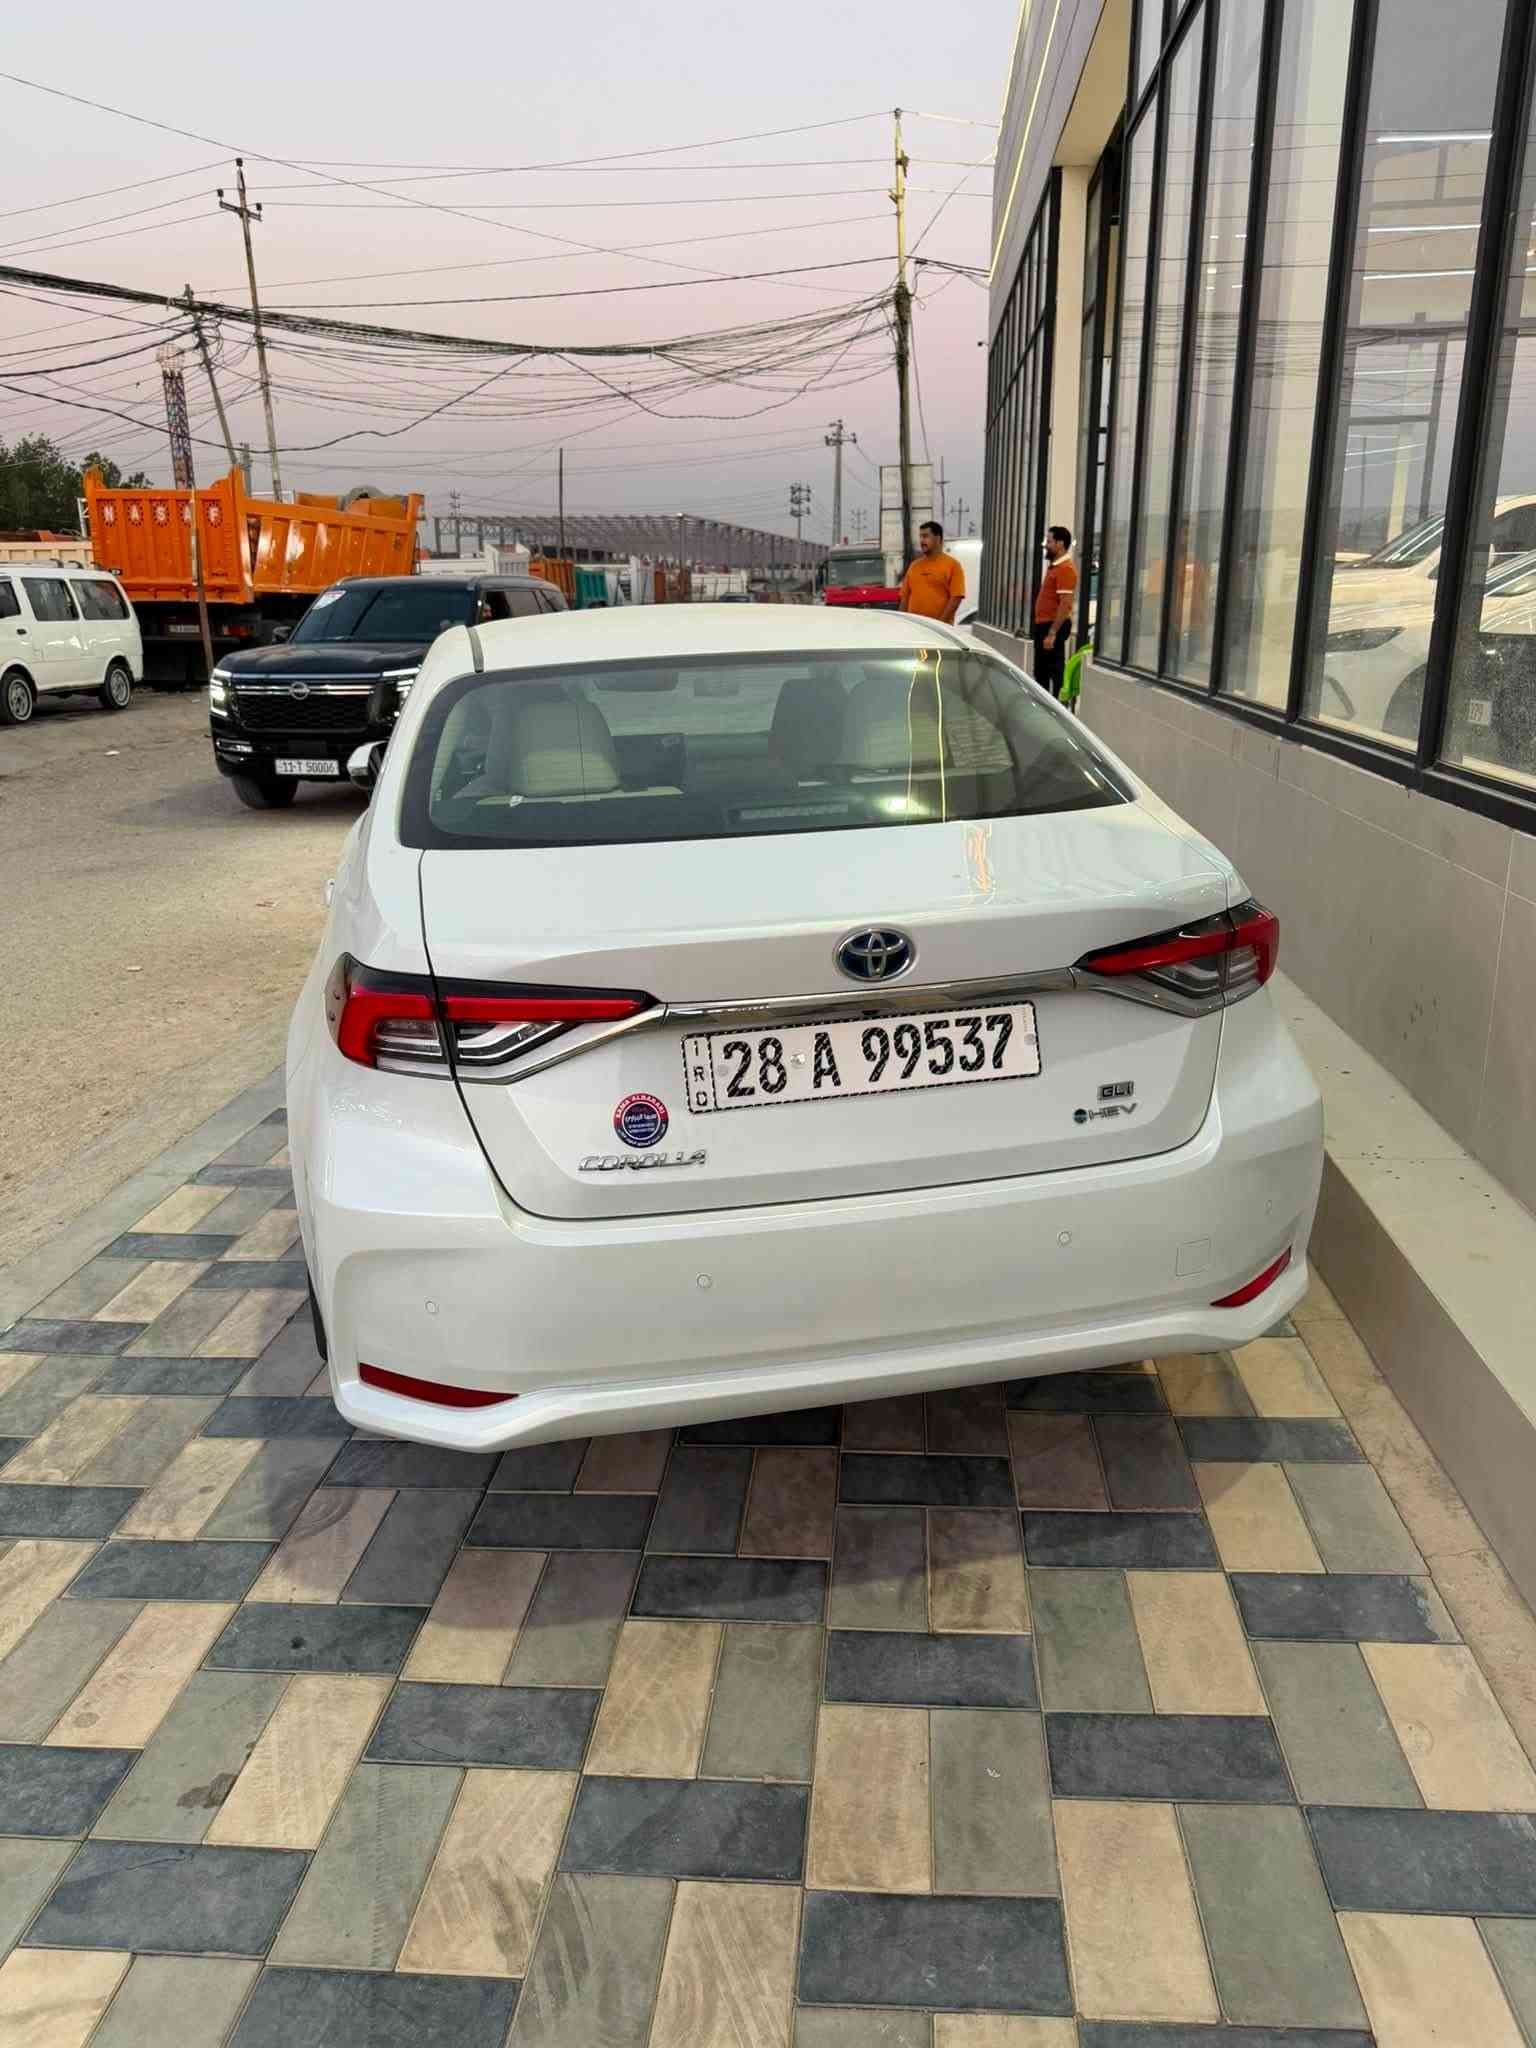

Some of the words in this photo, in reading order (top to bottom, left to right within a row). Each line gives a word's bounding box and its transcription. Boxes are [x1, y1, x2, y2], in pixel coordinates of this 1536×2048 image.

[722, 1037, 788, 1098] 28
[813, 1032, 842, 1089] A
[861, 1013, 1014, 1083] 99537
[1088, 1103, 1138, 1121] HEV
[578, 1150, 707, 1171] COROLLA
